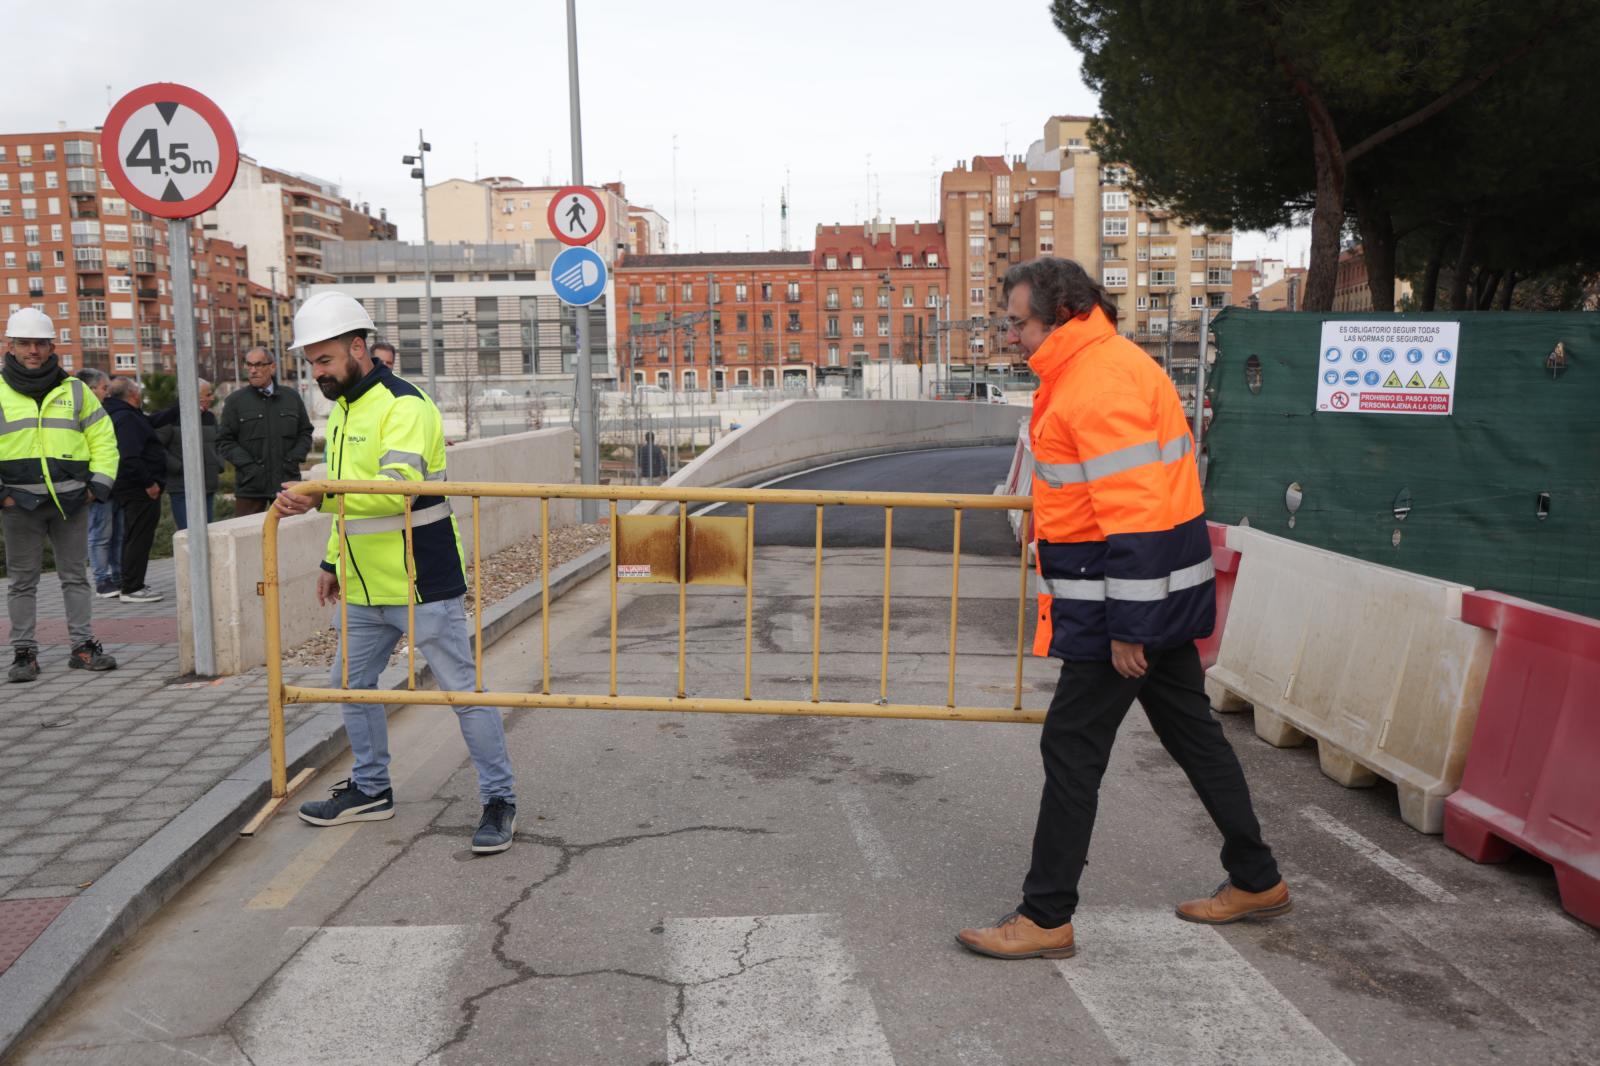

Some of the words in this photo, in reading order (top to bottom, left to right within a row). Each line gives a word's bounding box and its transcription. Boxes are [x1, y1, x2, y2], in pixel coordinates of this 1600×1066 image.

[126, 128, 213, 177] 4,5m
[1348, 326, 1391, 334] OBLIGATORIO
[1392, 326, 1416, 334] SEGUIR
[1396, 335, 1434, 343] SEGURIDAD
